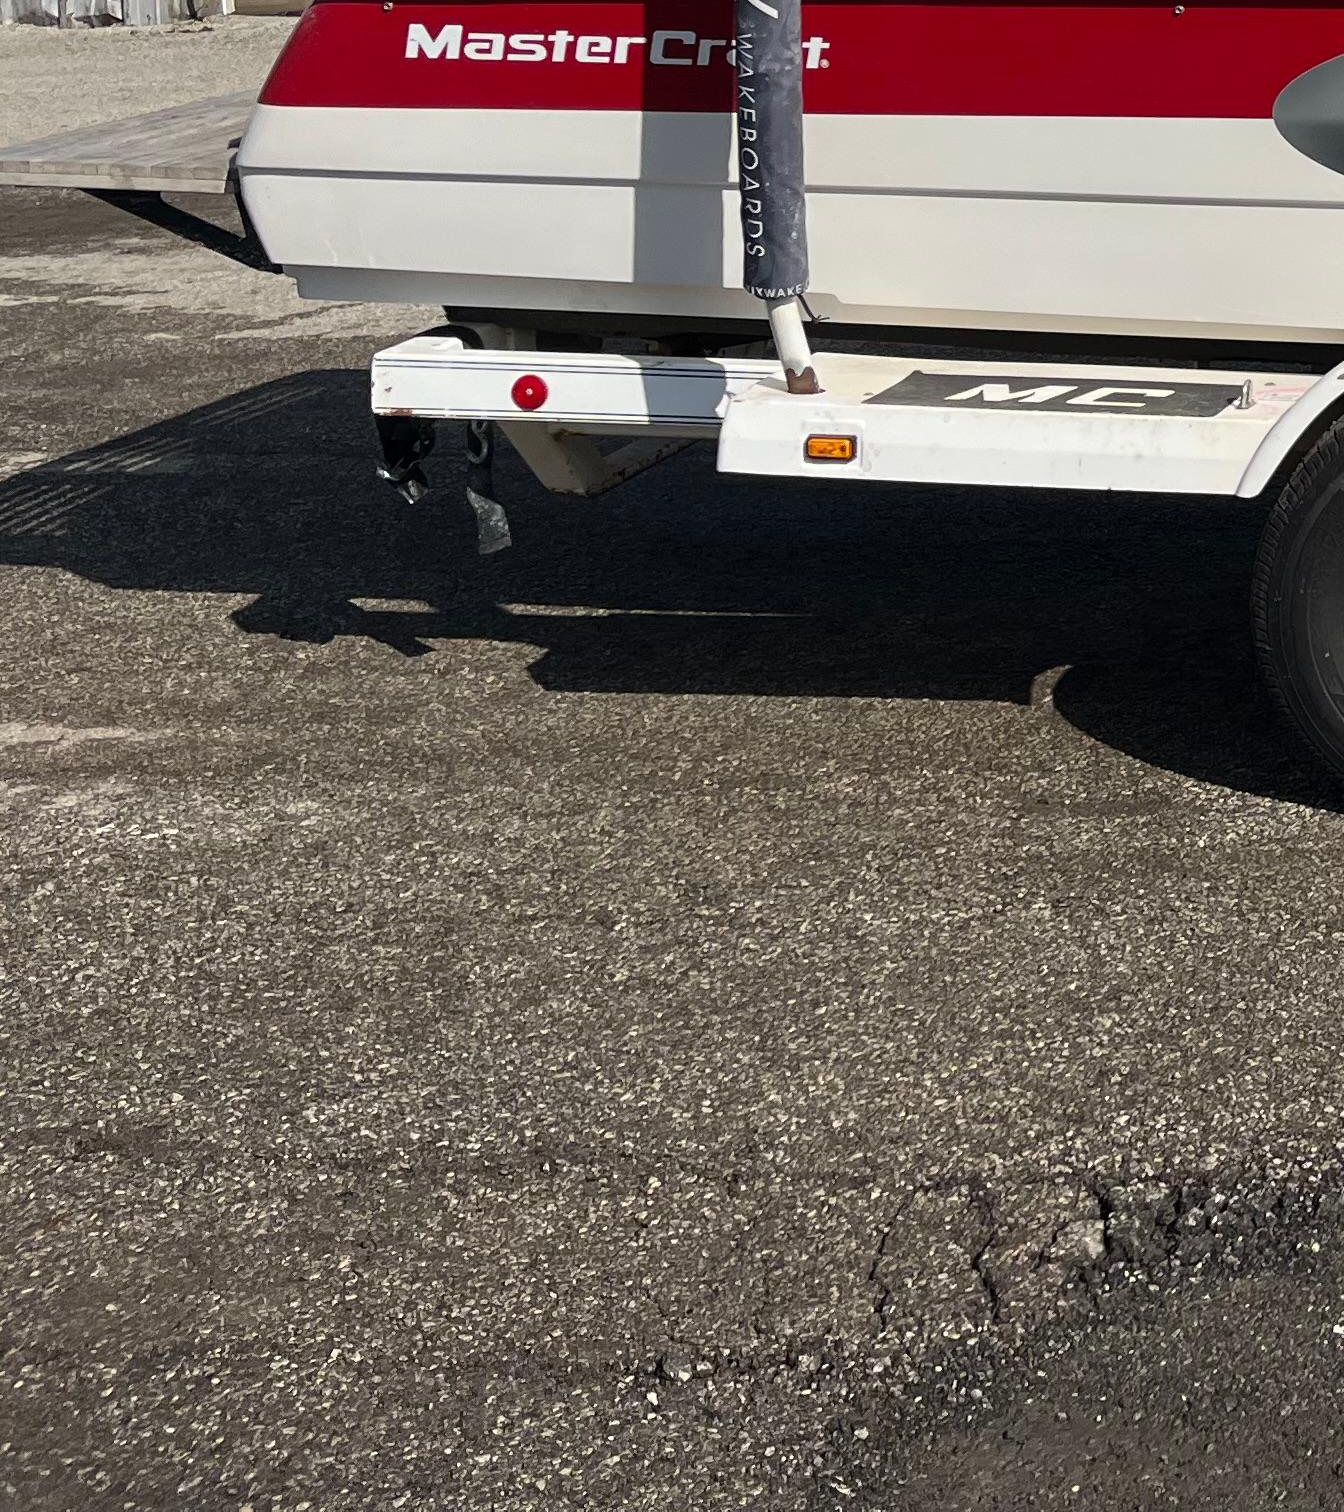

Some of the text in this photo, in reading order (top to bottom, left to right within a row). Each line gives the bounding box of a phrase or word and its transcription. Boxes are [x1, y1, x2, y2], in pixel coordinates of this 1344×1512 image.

[405, 23, 830, 69] MasterCrt
[737, 34, 766, 258] WAKEBOARDS
[749, 282, 806, 299] IXWAKE
[944, 383, 1176, 407] MC
